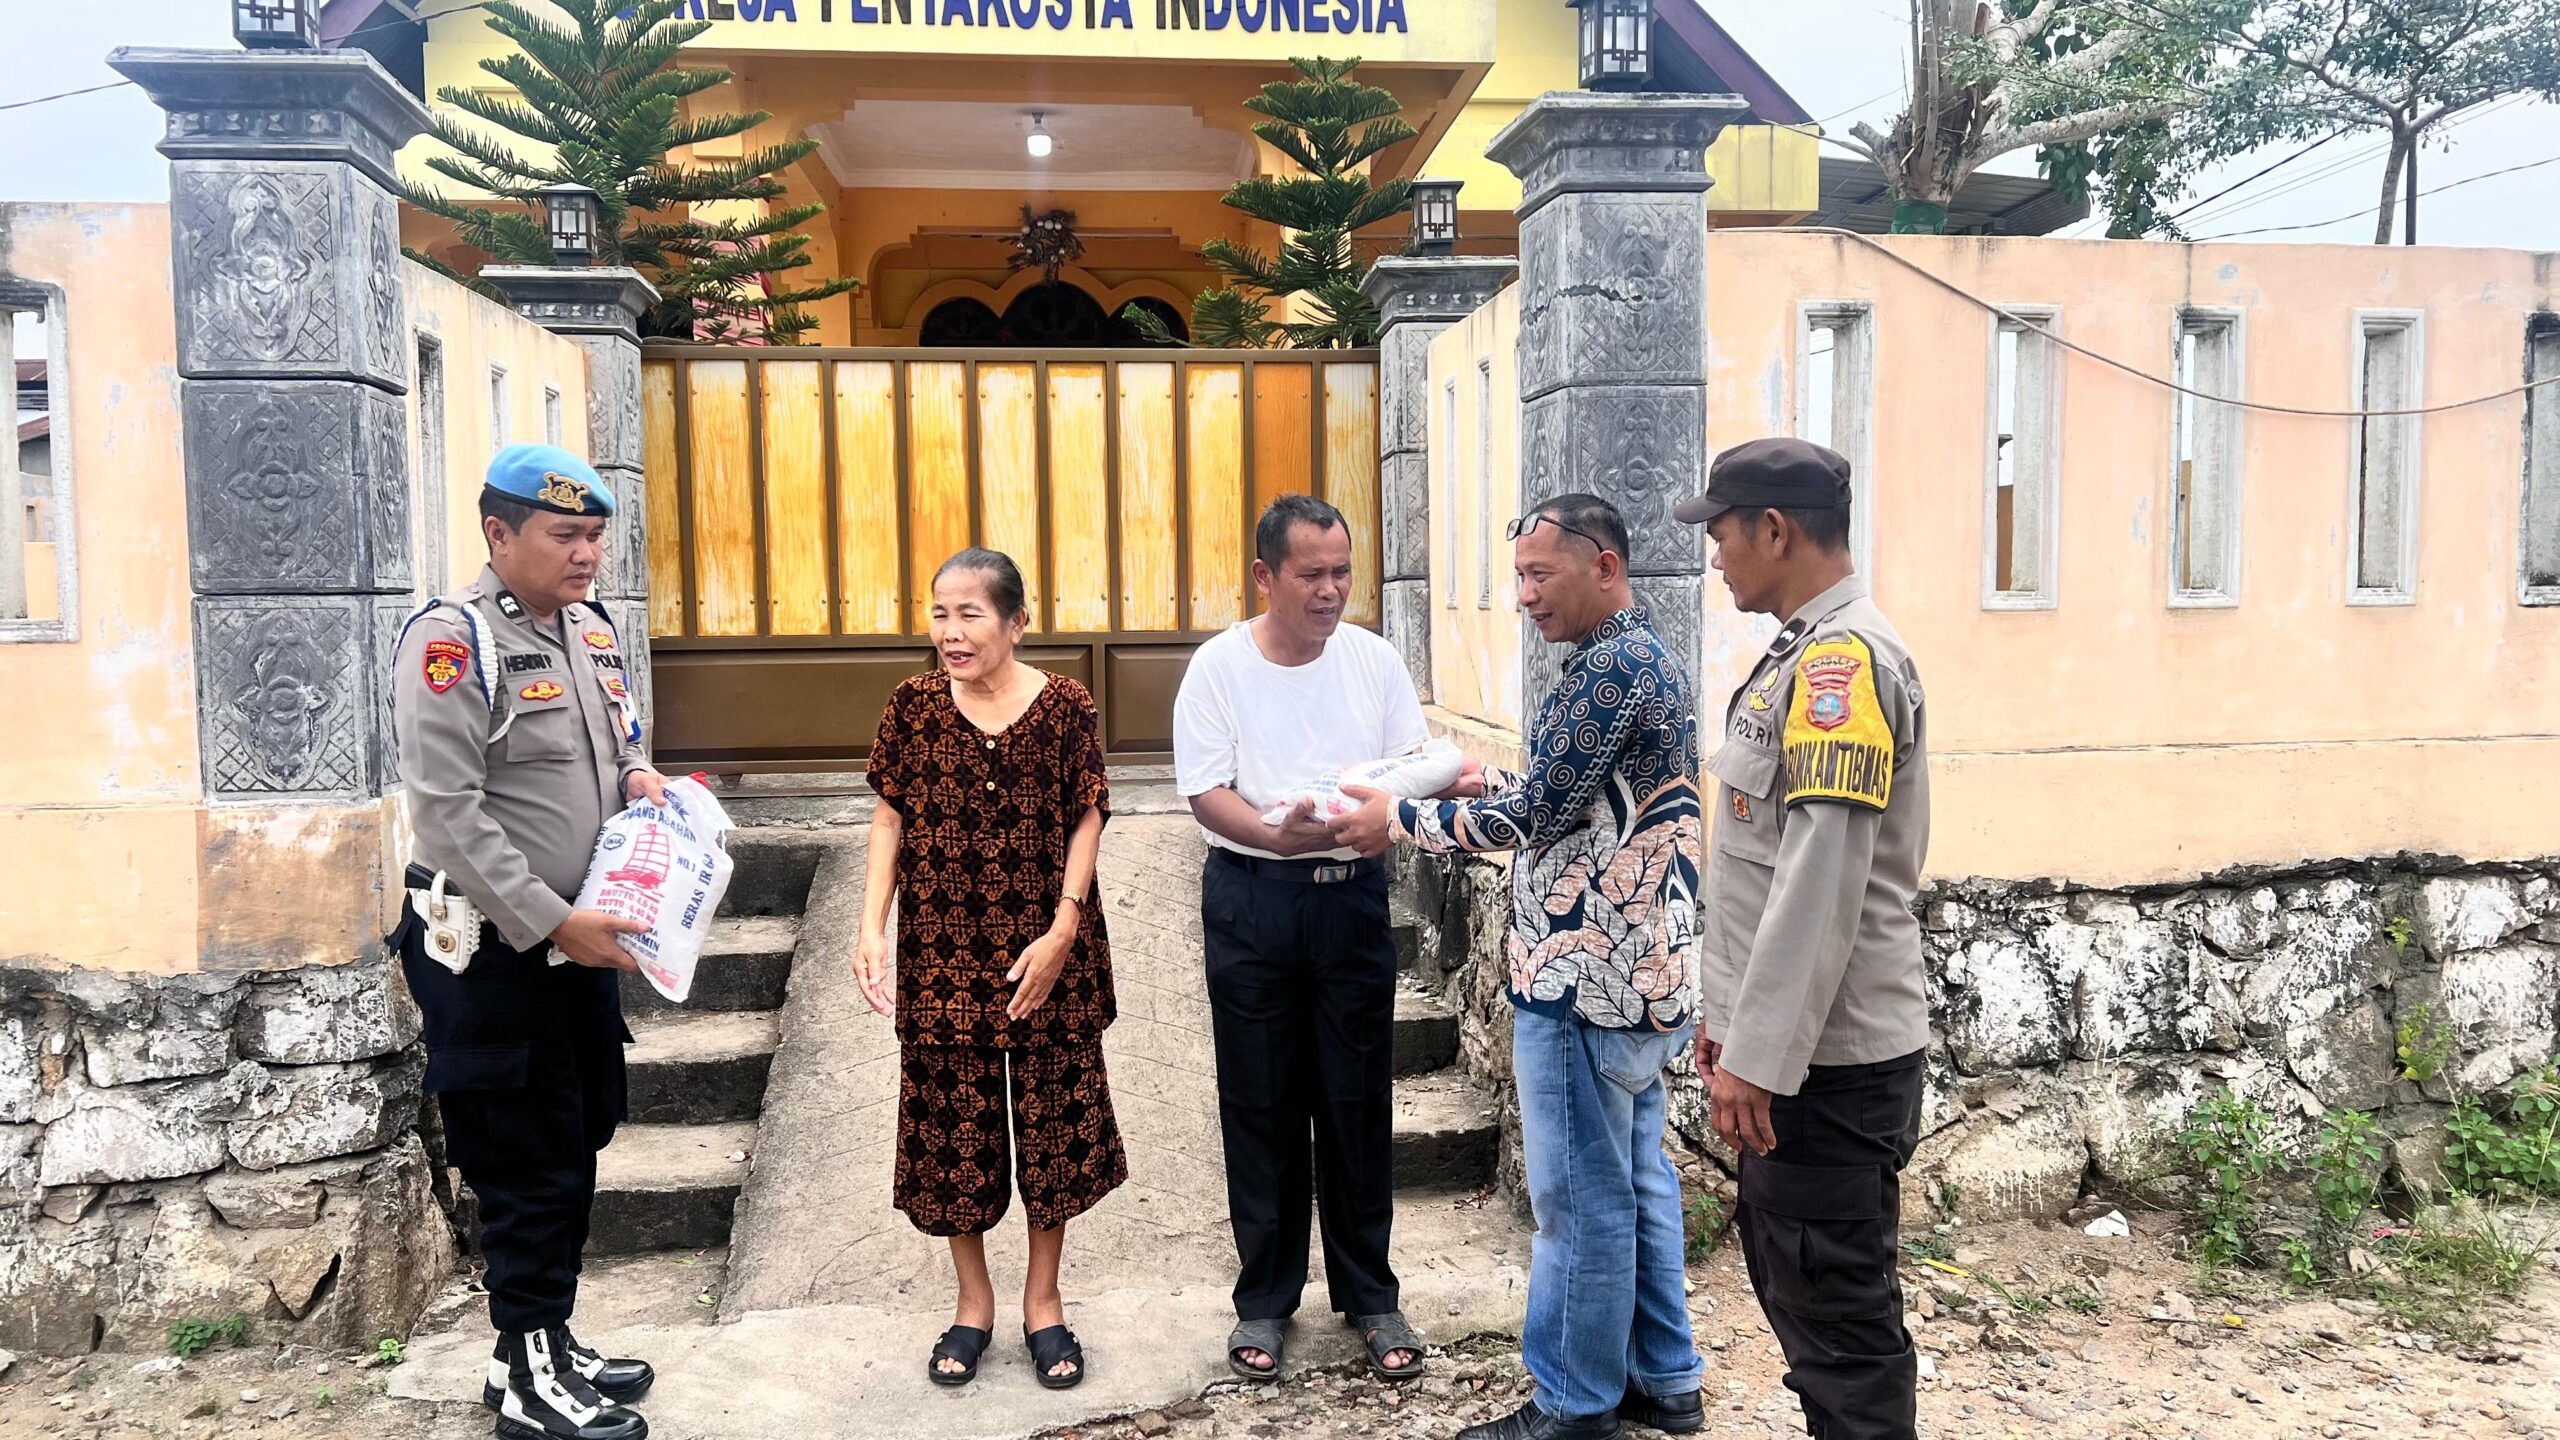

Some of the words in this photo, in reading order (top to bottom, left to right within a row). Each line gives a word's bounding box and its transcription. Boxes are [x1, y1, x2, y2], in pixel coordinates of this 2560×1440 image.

[430, 643, 465, 655] PROPAM
[1734, 715, 1773, 748] POLRI
[1784, 740, 1889, 801] BINKAMTIBMAS
[596, 898, 625, 908] NETTO
[600, 888, 634, 901] BRUTTO
[681, 888, 706, 930] BERAS
